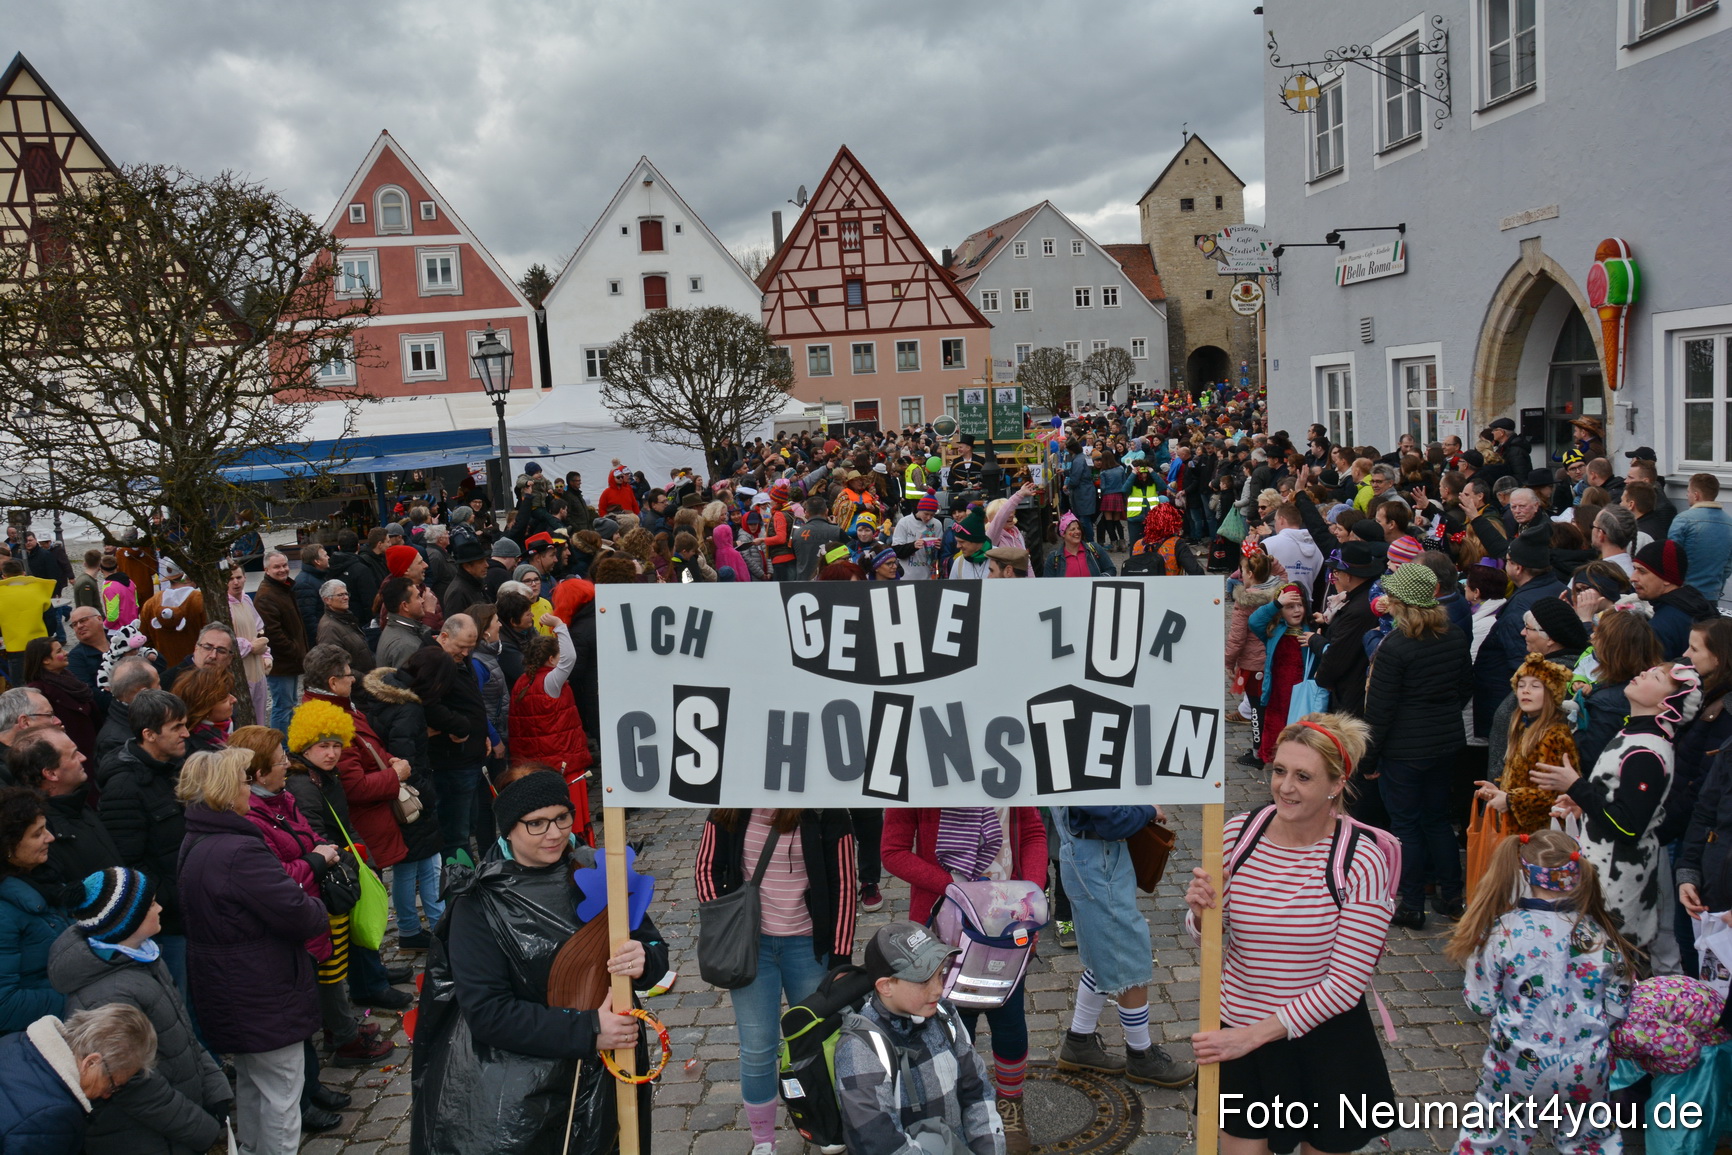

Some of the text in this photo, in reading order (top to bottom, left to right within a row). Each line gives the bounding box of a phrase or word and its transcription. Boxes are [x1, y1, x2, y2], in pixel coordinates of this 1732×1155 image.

[1229, 226, 1259, 234] Pizzeria
[1229, 246, 1260, 254] Eisdiele
[1347, 260, 1392, 279] Bella Roma
[619, 583, 1188, 679] ICH GEHE ZUR
[616, 695, 1217, 800] GS HOLNSTEIN
